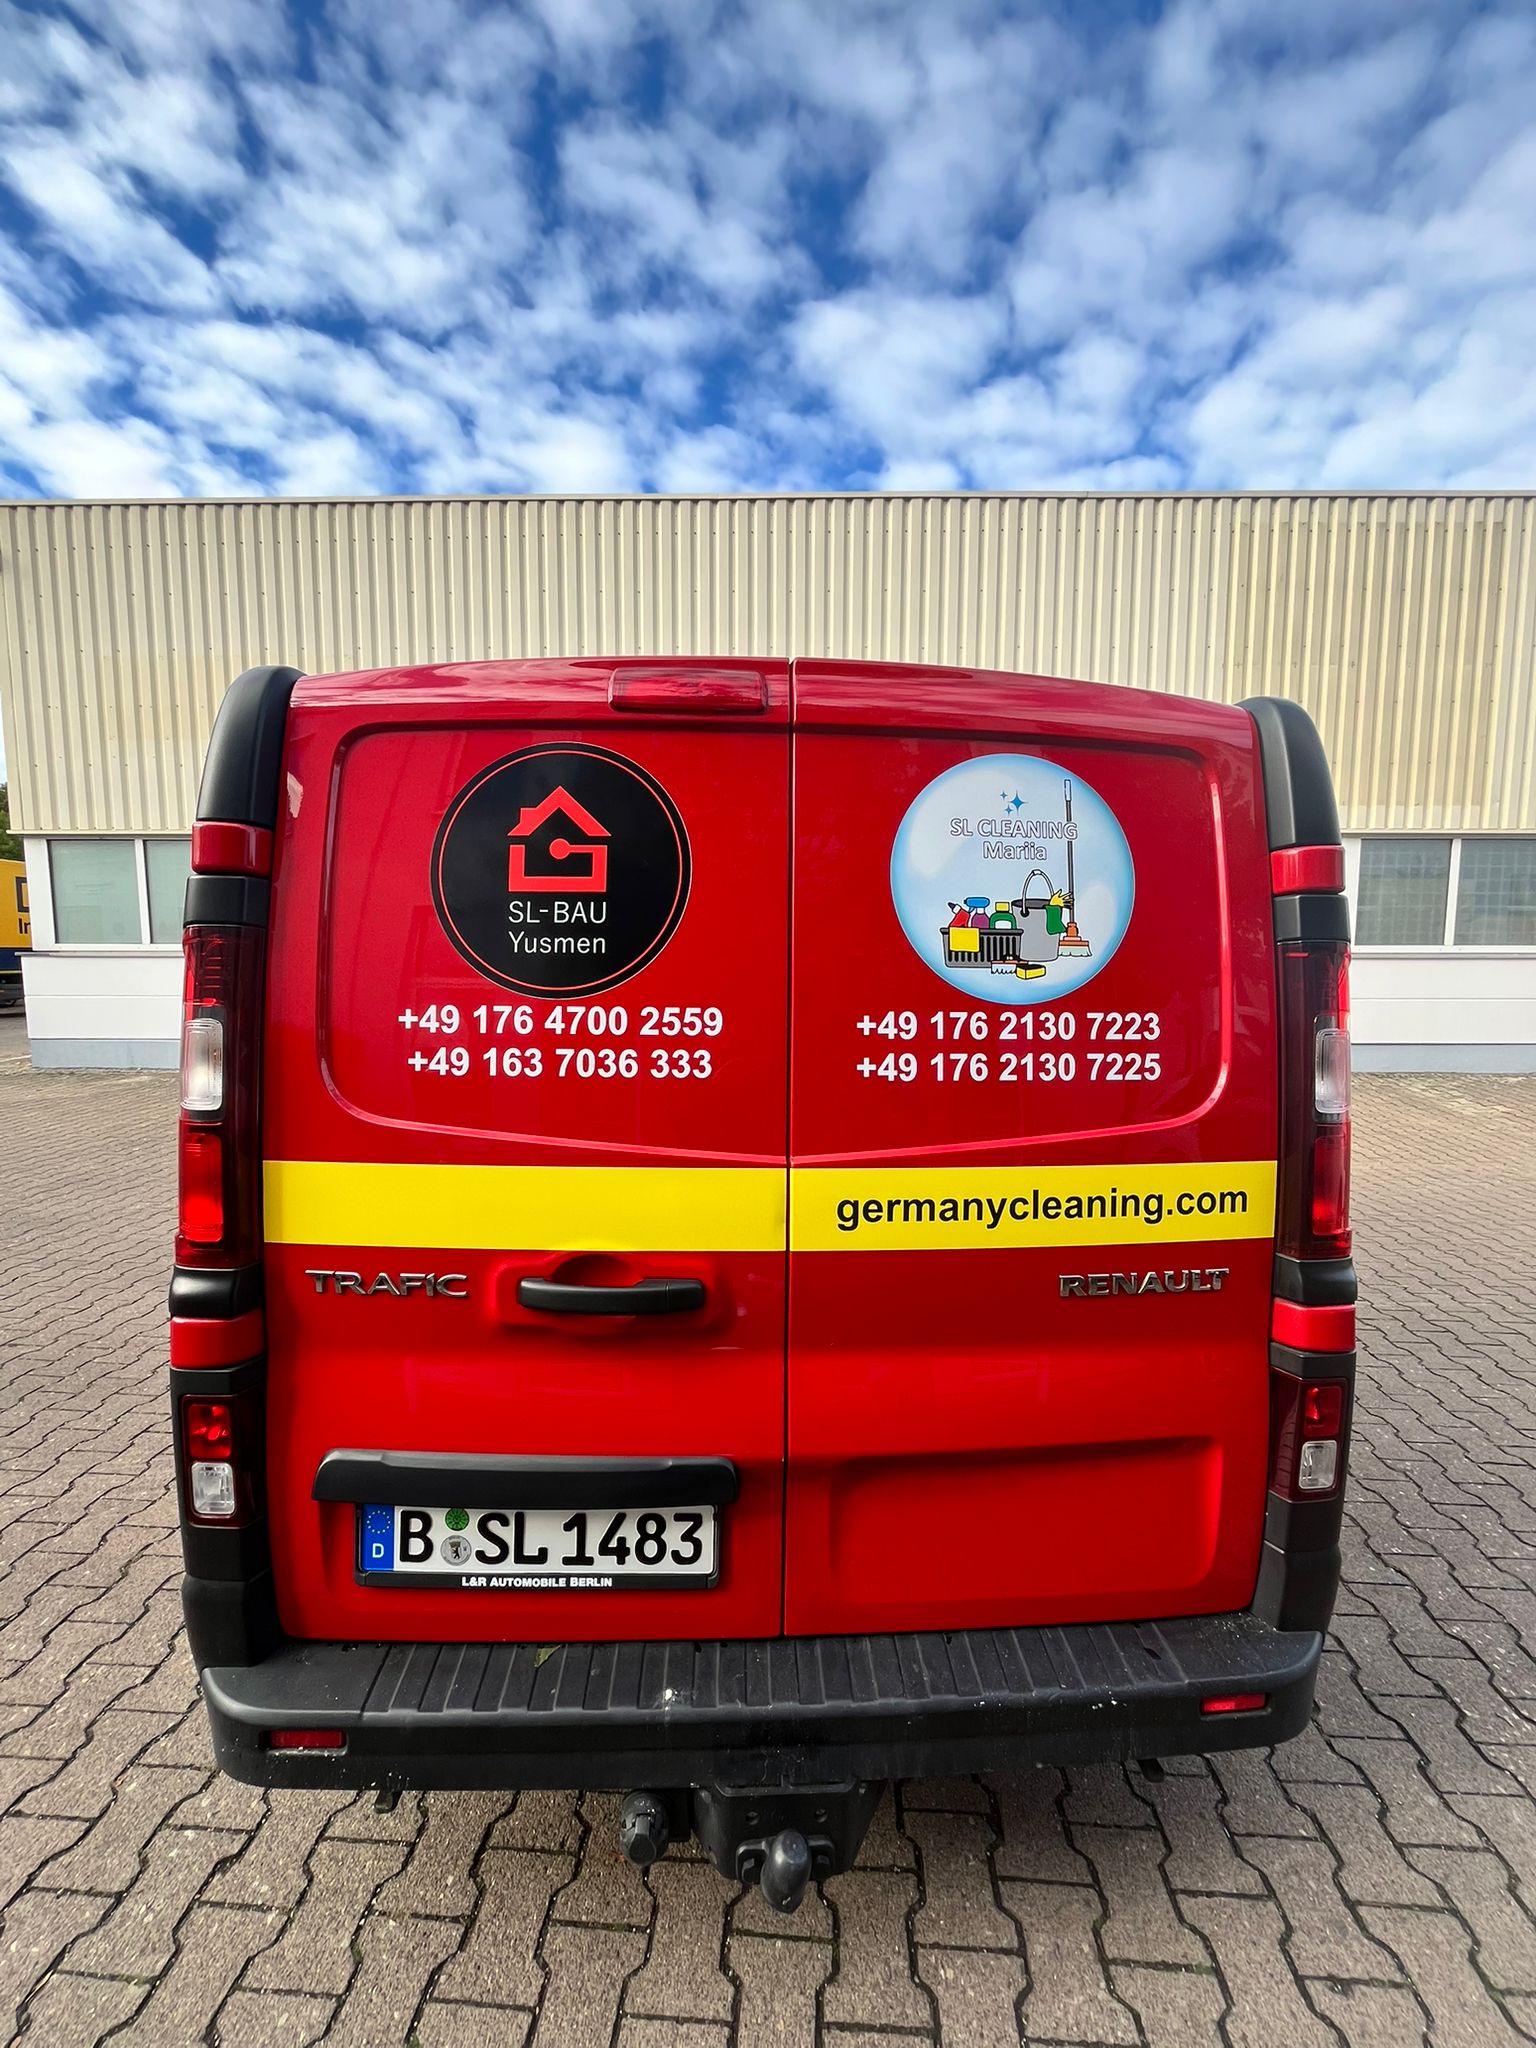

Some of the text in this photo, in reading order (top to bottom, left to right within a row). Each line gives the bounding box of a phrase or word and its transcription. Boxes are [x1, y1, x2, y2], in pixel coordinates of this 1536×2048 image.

[950, 818, 1078, 840] SL CLEANING
[982, 841, 1047, 861] Mariia
[508, 900, 607, 924] SL-BAU
[508, 931, 606, 954] Yusmen
[398, 1005, 724, 1037] +49 176 4700 2559
[856, 1011, 1160, 1040] +49 176 2130 7223
[407, 1047, 712, 1079] +49 163 7036 333
[856, 1053, 1161, 1082] +49 176 2130 7225
[836, 1187, 1248, 1232] germanycleaning.com
[305, 1269, 467, 1297] TRAFIC
[1059, 1268, 1229, 1298] RENAULT
[372, 1543, 385, 1558] D
[400, 1508, 703, 1566] B SL 1483
[462, 1576, 612, 1587] L&R AUTOMOBILE BERLIN
